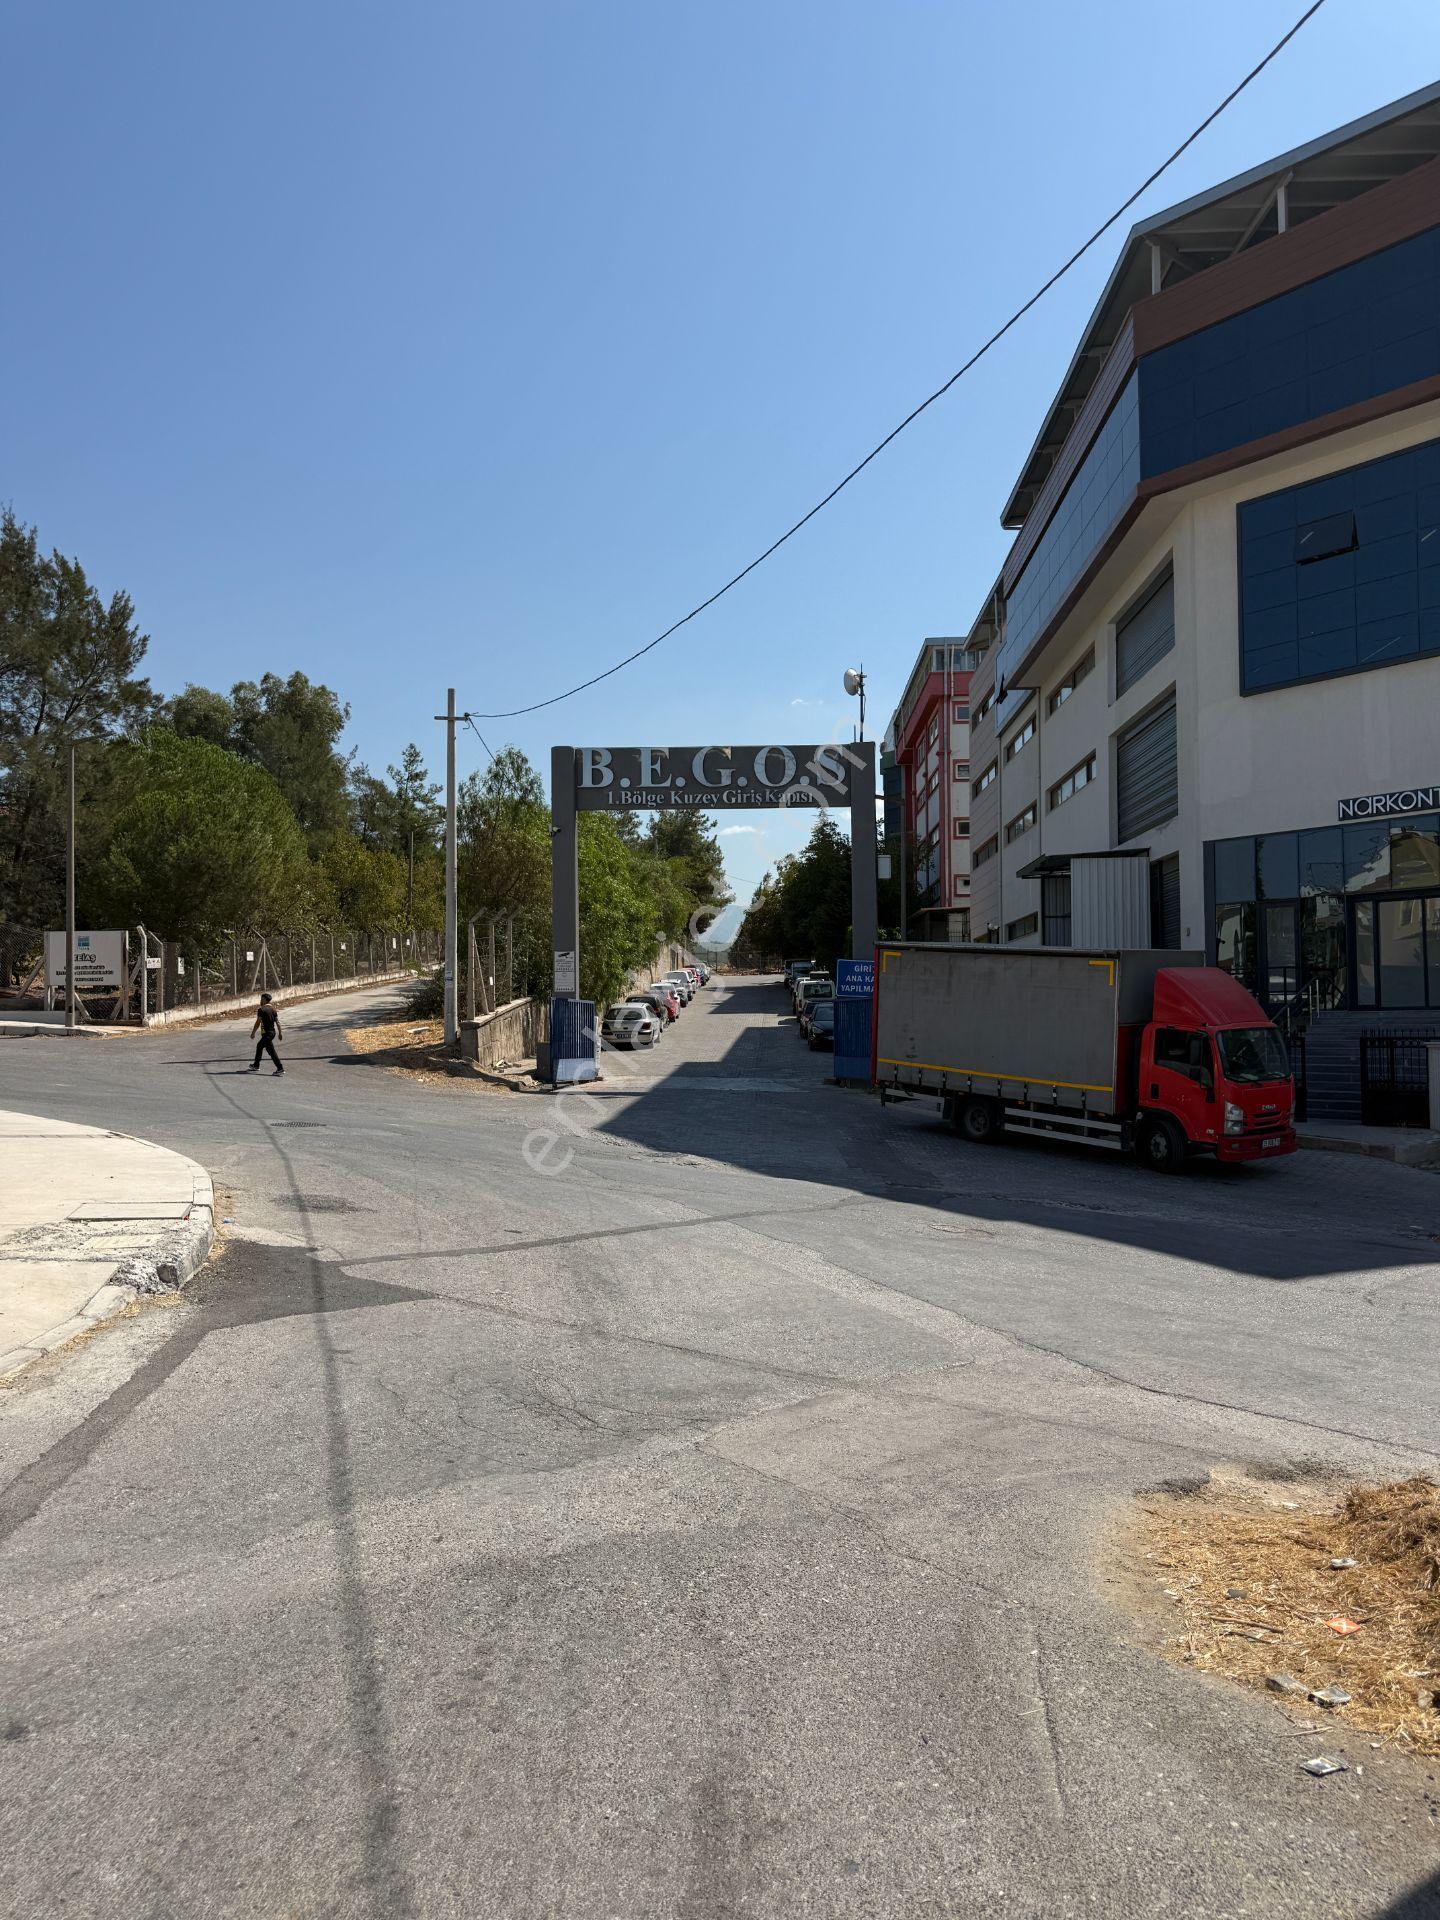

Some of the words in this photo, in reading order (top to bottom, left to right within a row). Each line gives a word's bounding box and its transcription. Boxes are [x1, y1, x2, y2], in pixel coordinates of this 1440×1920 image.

[607, 788, 665, 808] 1.Bölge
[669, 790, 720, 807] Kuzey
[722, 789, 763, 805] Giriş
[764, 789, 814, 805] Kapısı
